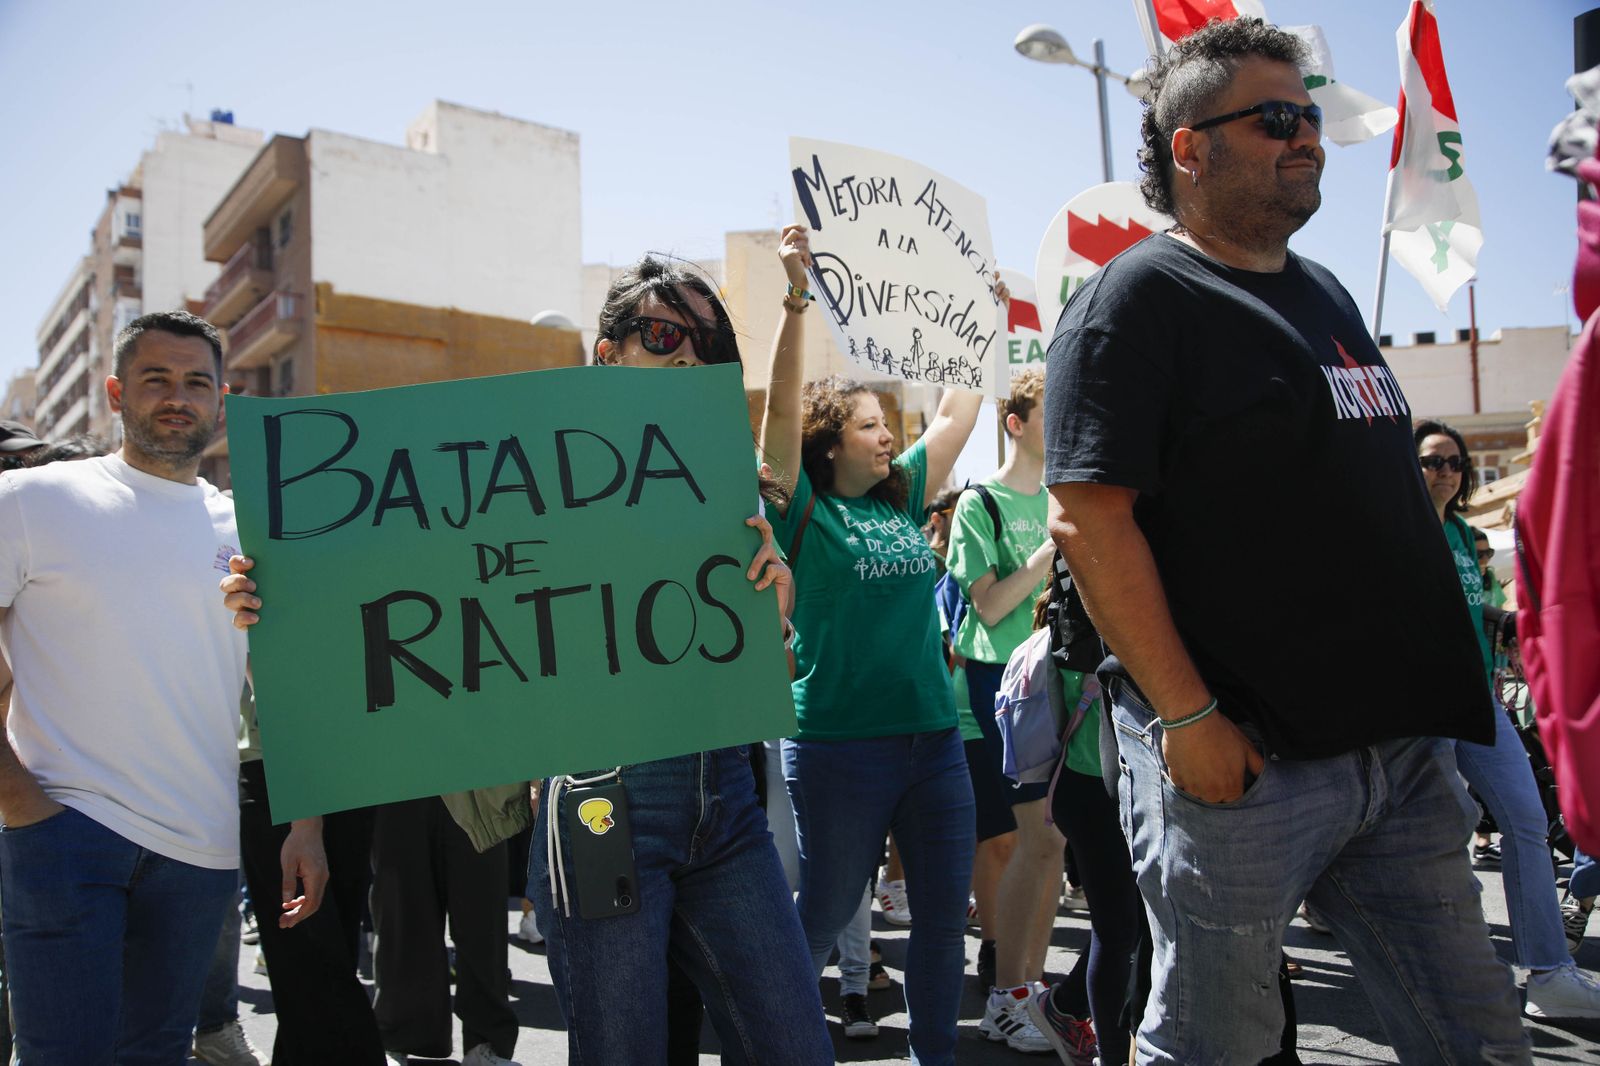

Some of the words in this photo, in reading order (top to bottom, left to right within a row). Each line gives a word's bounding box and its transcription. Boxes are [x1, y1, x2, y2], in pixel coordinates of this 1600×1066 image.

[791, 153, 902, 232] MEJORA
[877, 228, 890, 249] A
[897, 234, 919, 255] LA
[1320, 365, 1407, 420] KORTATU
[263, 408, 706, 540] BAJADA
[471, 540, 549, 584] DE
[360, 554, 746, 714] RATIOS
